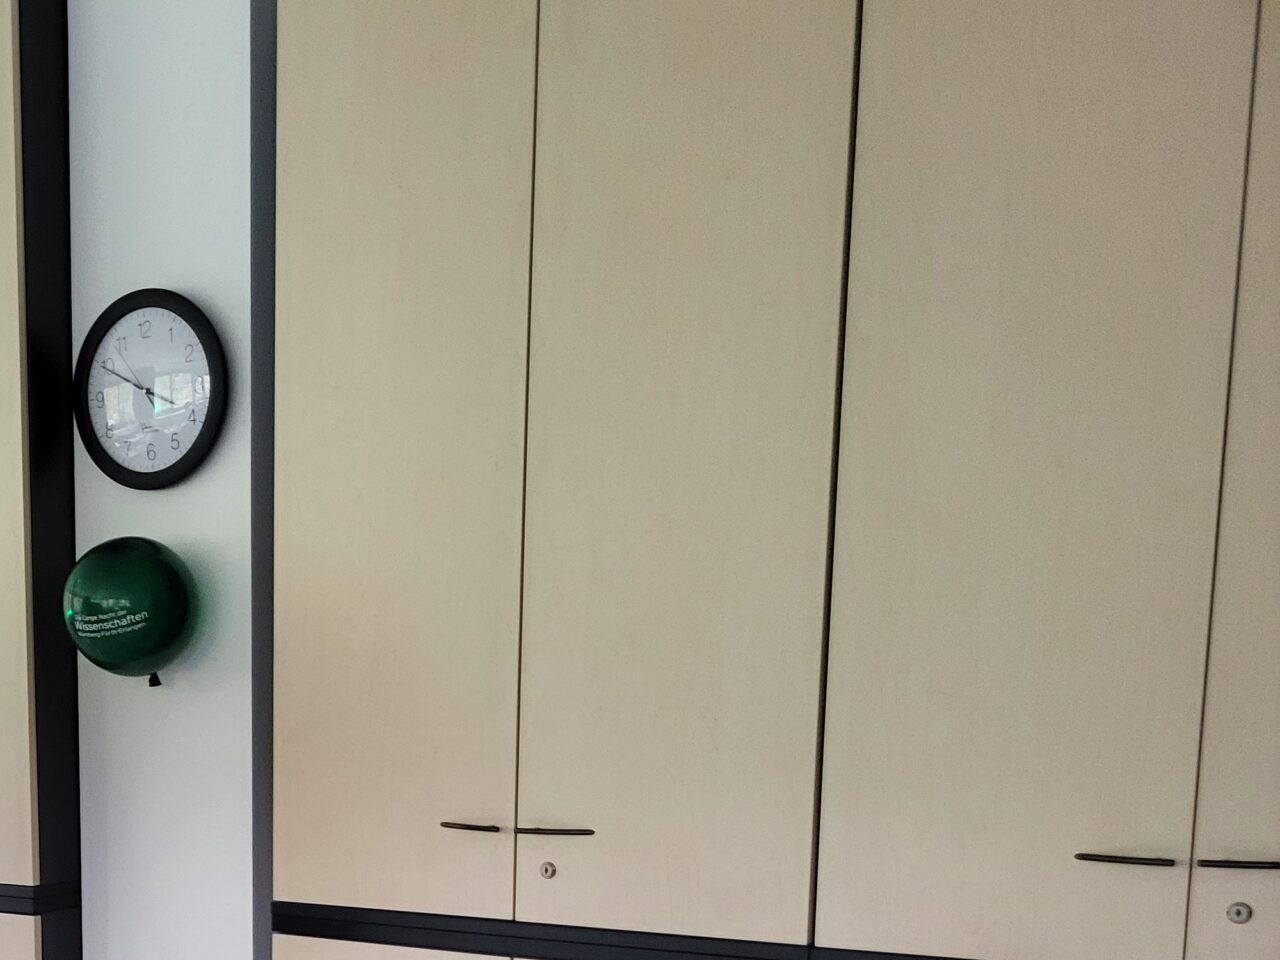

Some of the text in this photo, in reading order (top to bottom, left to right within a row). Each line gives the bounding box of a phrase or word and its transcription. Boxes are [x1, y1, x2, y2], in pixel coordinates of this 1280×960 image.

[138, 320, 152, 338] 12
[168, 328, 174, 343] 1
[117, 337, 128, 351] 11
[185, 344, 194, 363] 2
[194, 376, 206, 394] 3
[96, 391, 105, 408] 9
[187, 409, 197, 425] 4
[106, 423, 114, 438] 8
[124, 441, 132, 456] 7
[171, 433, 180, 450] 5
[147, 443, 157, 461] 6
[73, 611, 149, 631] Wissenschaften
